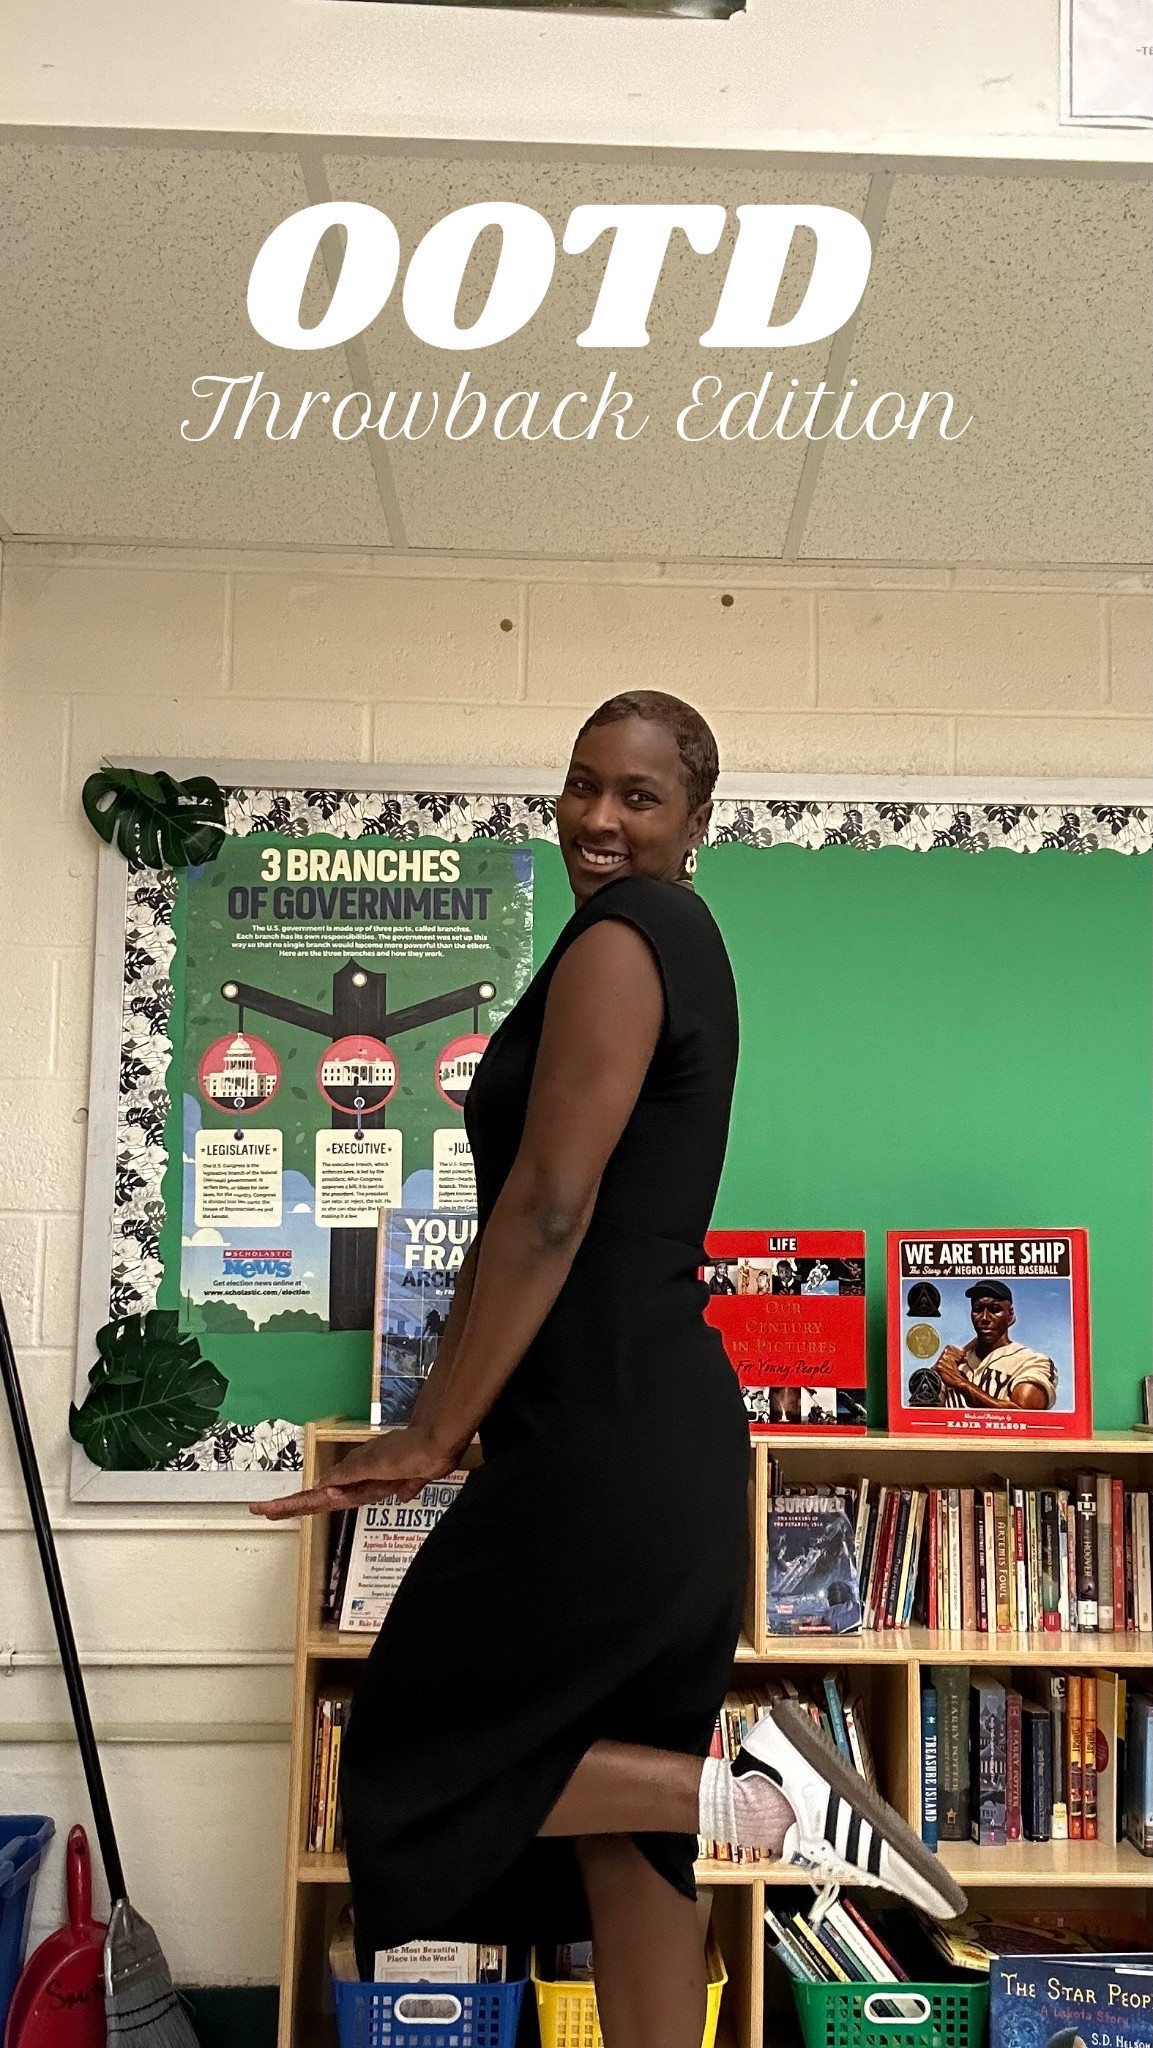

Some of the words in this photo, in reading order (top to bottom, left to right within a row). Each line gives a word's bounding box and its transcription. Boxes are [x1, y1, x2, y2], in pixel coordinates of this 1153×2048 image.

[261, 848, 281, 882] 3
[287, 849, 461, 882] BRANCHES
[228, 886, 268, 920] OF
[274, 886, 492, 920] GOVERNMENT
[207, 1144, 271, 1156] LEGISLATIVE
[332, 1142, 386, 1154] EXECUTIVE
[769, 1238, 796, 1250] LIFE
[905, 1244, 933, 1264] WE
[939, 1243, 973, 1264] ARE
[979, 1243, 1014, 1264] THE
[1020, 1242, 1065, 1263] SHIP
[909, 1266, 920, 1274] The
[922, 1266, 941, 1276] Story
[943, 1266, 952, 1275] of
[955, 1266, 983, 1275] NEGRO
[986, 1265, 1016, 1275] LEAGUE
[1019, 1265, 1058, 1274] BASEBALL
[758, 1360, 791, 1381] Young
[795, 1359, 833, 1378] People
[775, 1497, 845, 1512] SURVIVED
[366, 1507, 392, 1526] U.S.
[394, 1542, 416, 1551] Learning
[997, 1522, 1006, 1566] ARTEMIS
[1083, 1538, 1092, 1577] HOOVER
[925, 1735, 937, 1784] TREASURE
[925, 1786, 937, 1822] ISLAND
[1000, 1972, 1036, 1998] THE
[1047, 1977, 1097, 2004] STAR
[1040, 2006, 1048, 2016] A
[1054, 2006, 1092, 2020] Lakota
[1097, 2011, 1129, 2028] Story
[1092, 2033, 1111, 2046] S.D.
